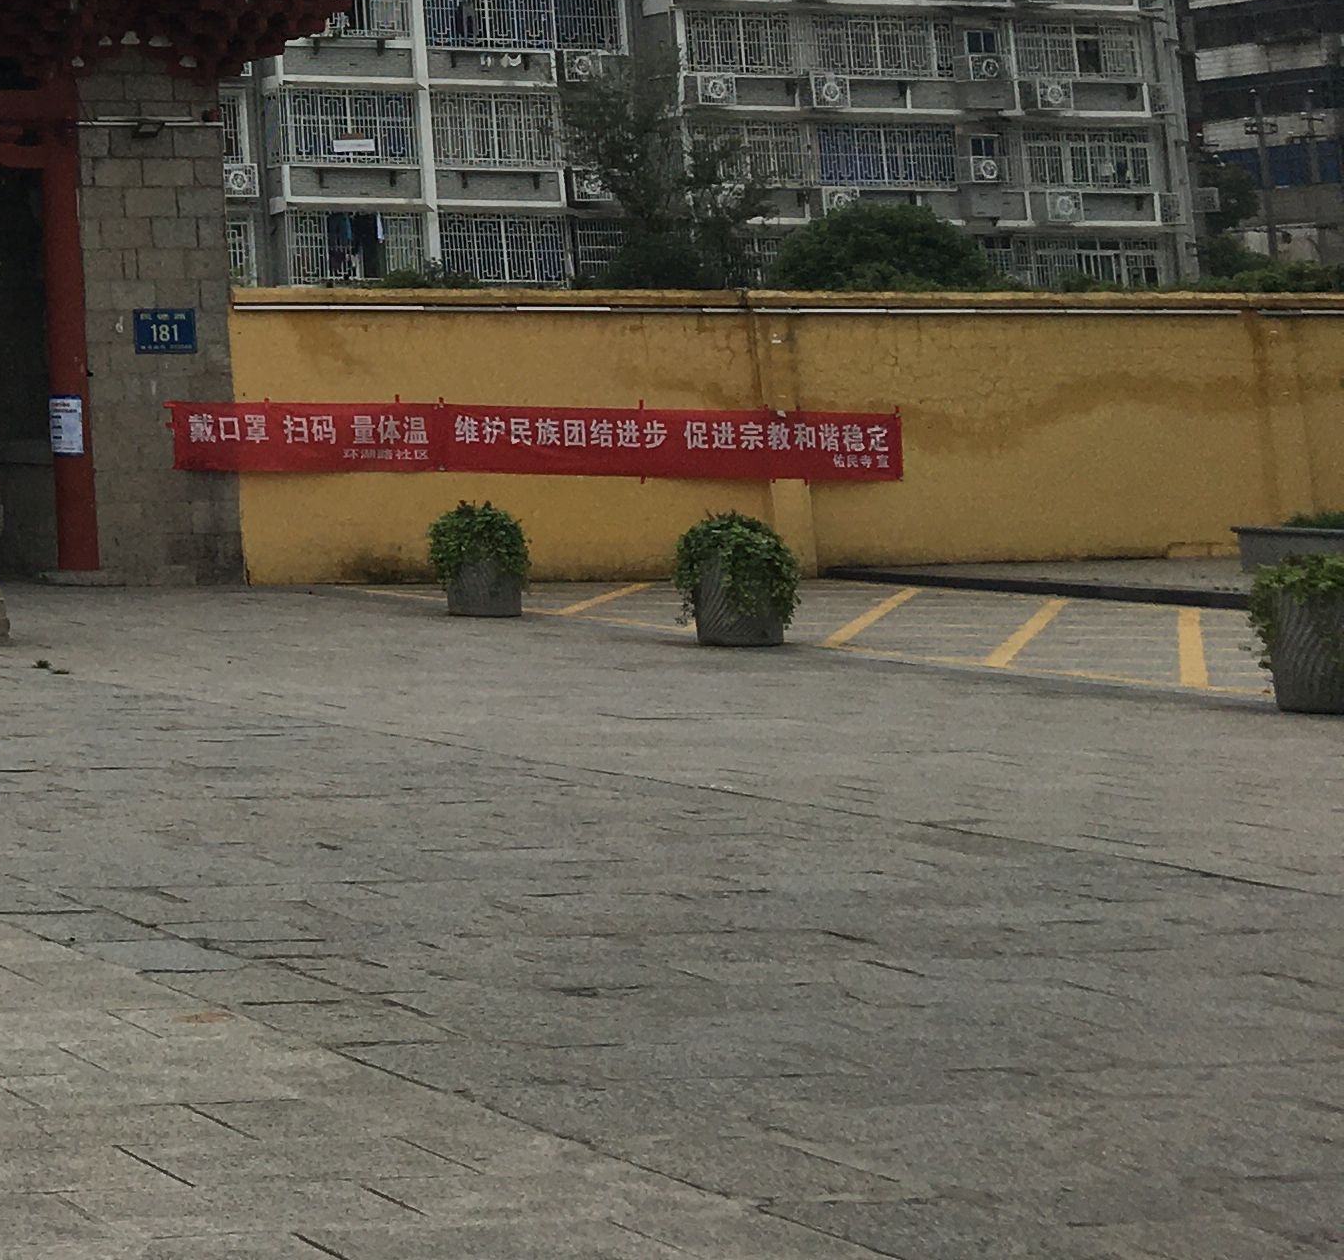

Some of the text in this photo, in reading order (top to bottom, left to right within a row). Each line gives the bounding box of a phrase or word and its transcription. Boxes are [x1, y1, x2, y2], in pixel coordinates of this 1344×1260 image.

[150, 324, 179, 342] 181
[188, 413, 890, 453] 戴口罩 扫码 量体温 维护民族团结进步 促进宗教和谐稳定
